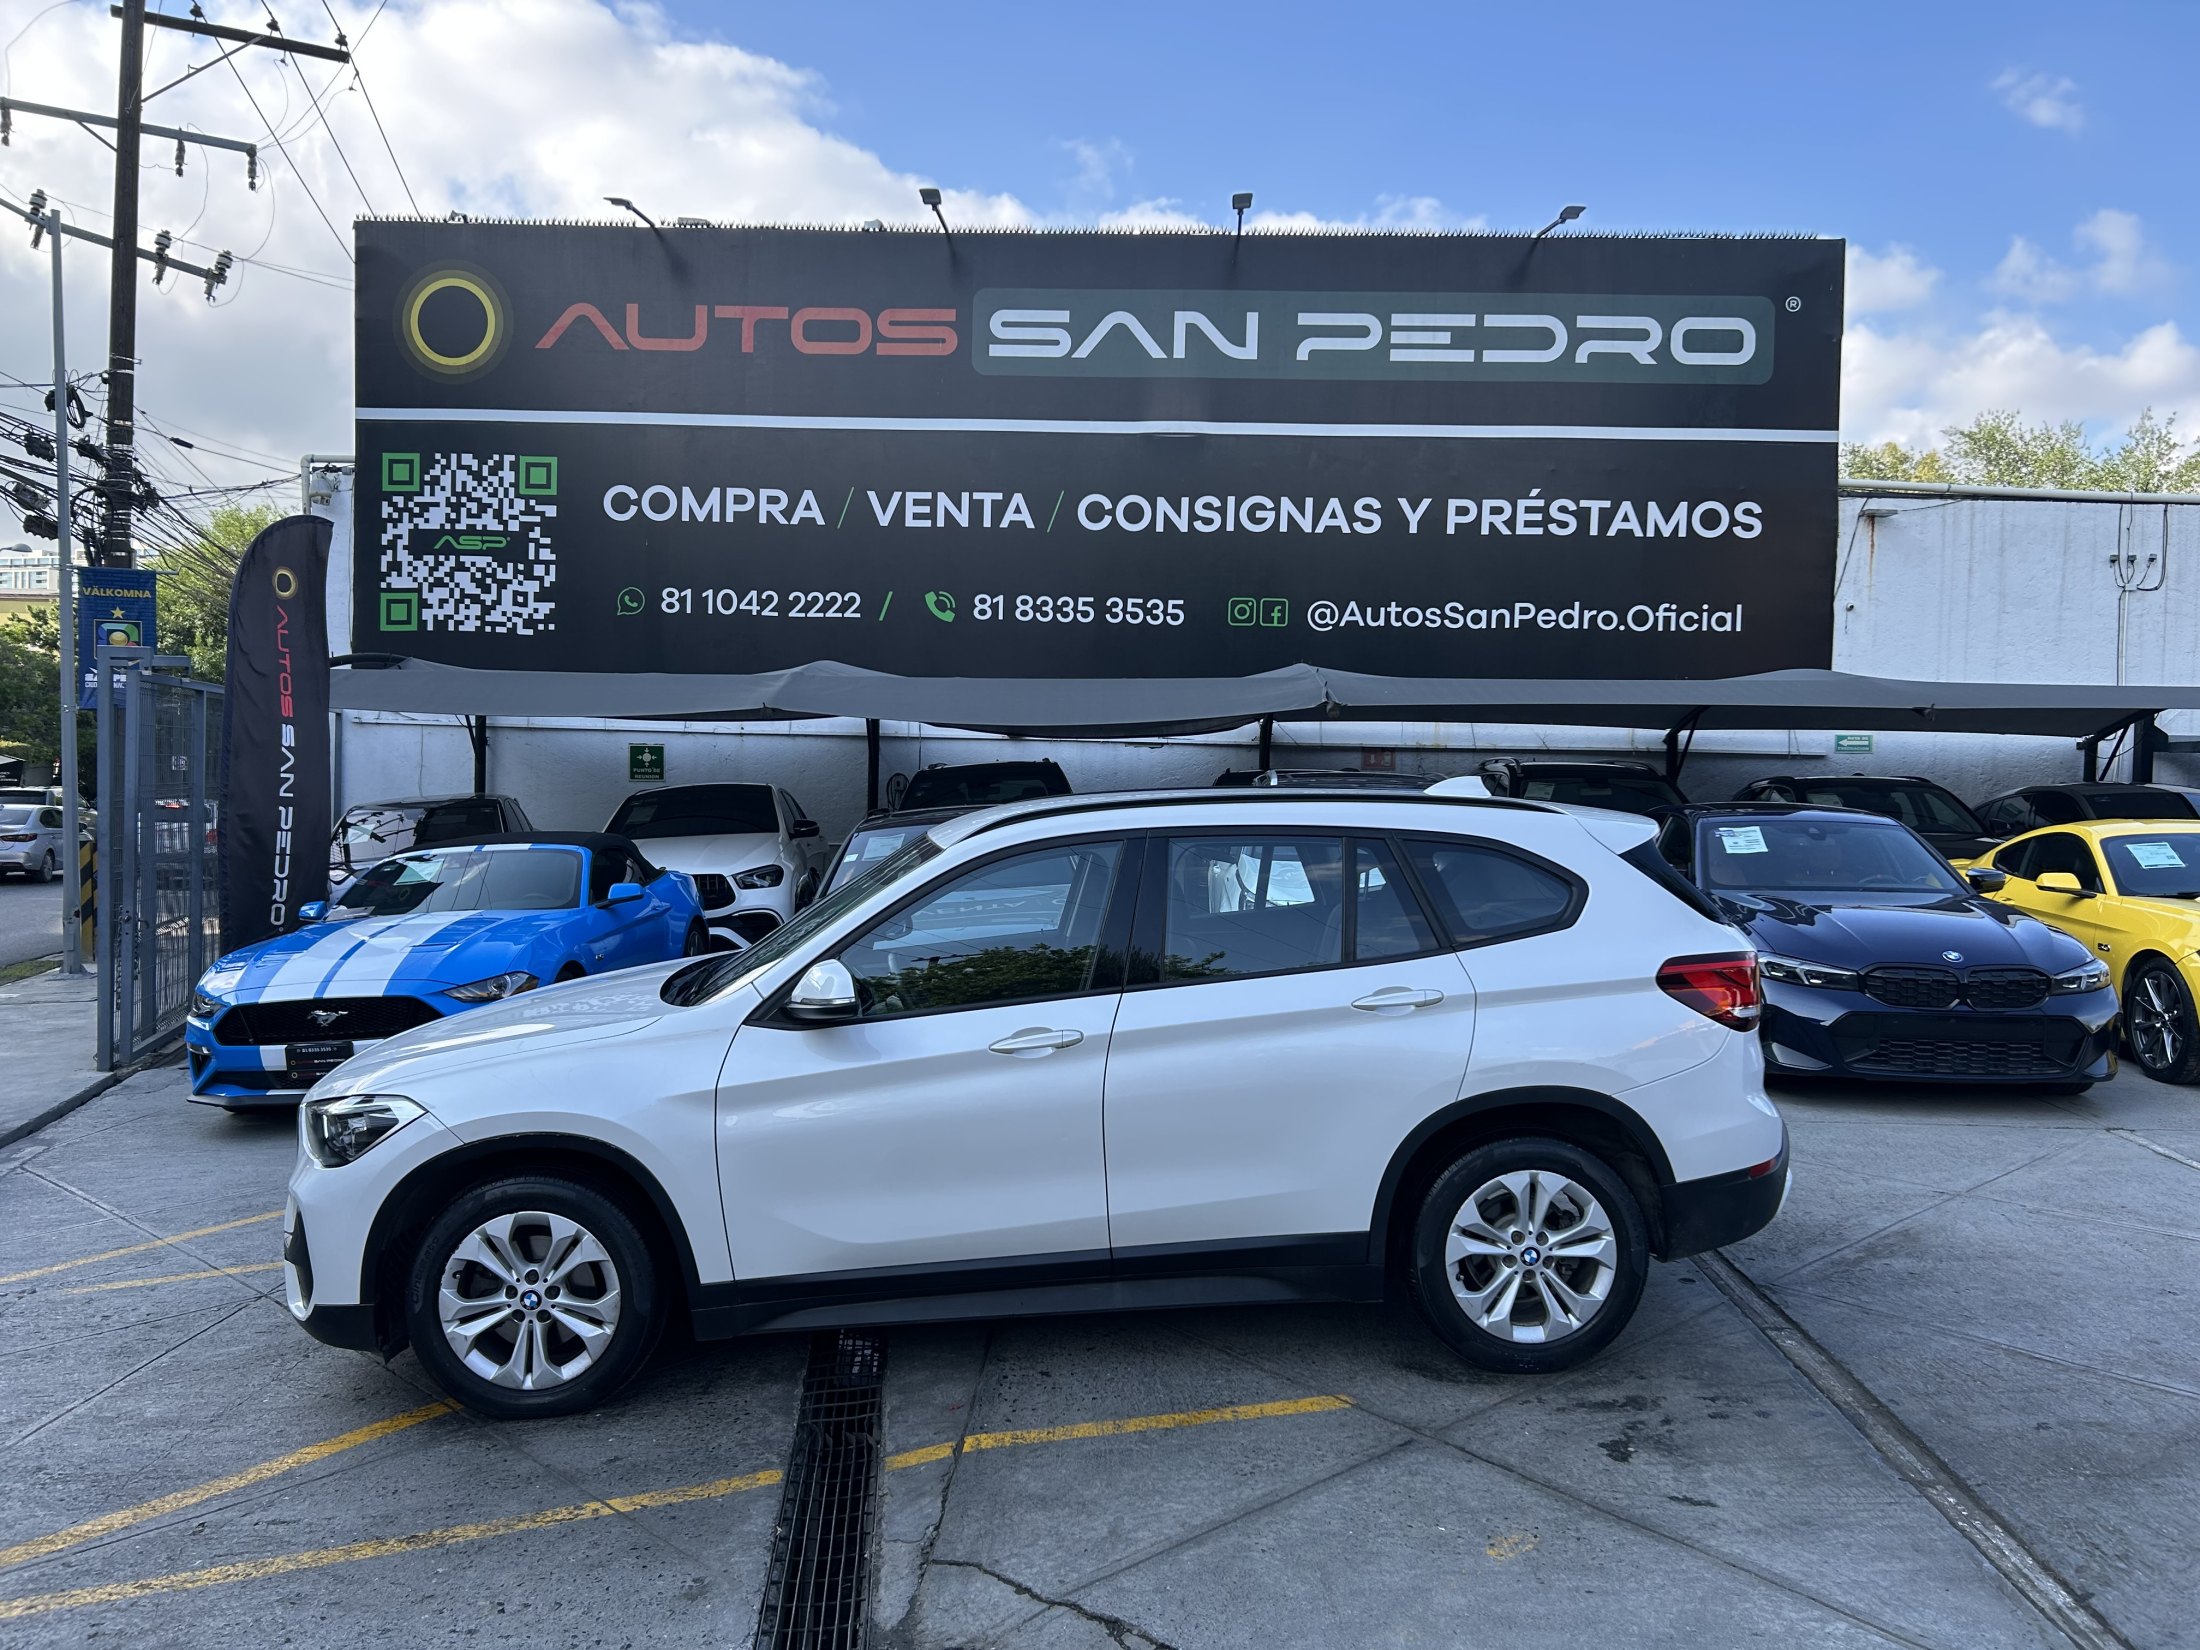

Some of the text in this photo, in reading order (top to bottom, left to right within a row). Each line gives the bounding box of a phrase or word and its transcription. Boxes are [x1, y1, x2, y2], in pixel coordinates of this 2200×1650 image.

[536, 302, 959, 356] AUTOS
[988, 308, 1259, 361] SAN
[1296, 312, 1756, 366] PEDRO
[602, 484, 826, 526] COMPRA
[866, 490, 1036, 529] VENTA
[1077, 493, 1382, 535] CONSIGNAS
[1396, 497, 1433, 534] Y
[1446, 487, 1763, 539] PRÉSTAMOS
[433, 535, 507, 550] ASP
[82, 585, 152, 598] VÄLKOMNA
[660, 587, 692, 614] 81
[701, 588, 779, 617] 1042
[788, 591, 861, 618] 2222
[973, 594, 1185, 626] 81 8335 3535
[1306, 600, 1743, 634] @AutosSanPedro.Oficial
[270, 604, 296, 926] AUTOS SAN PEDRO
